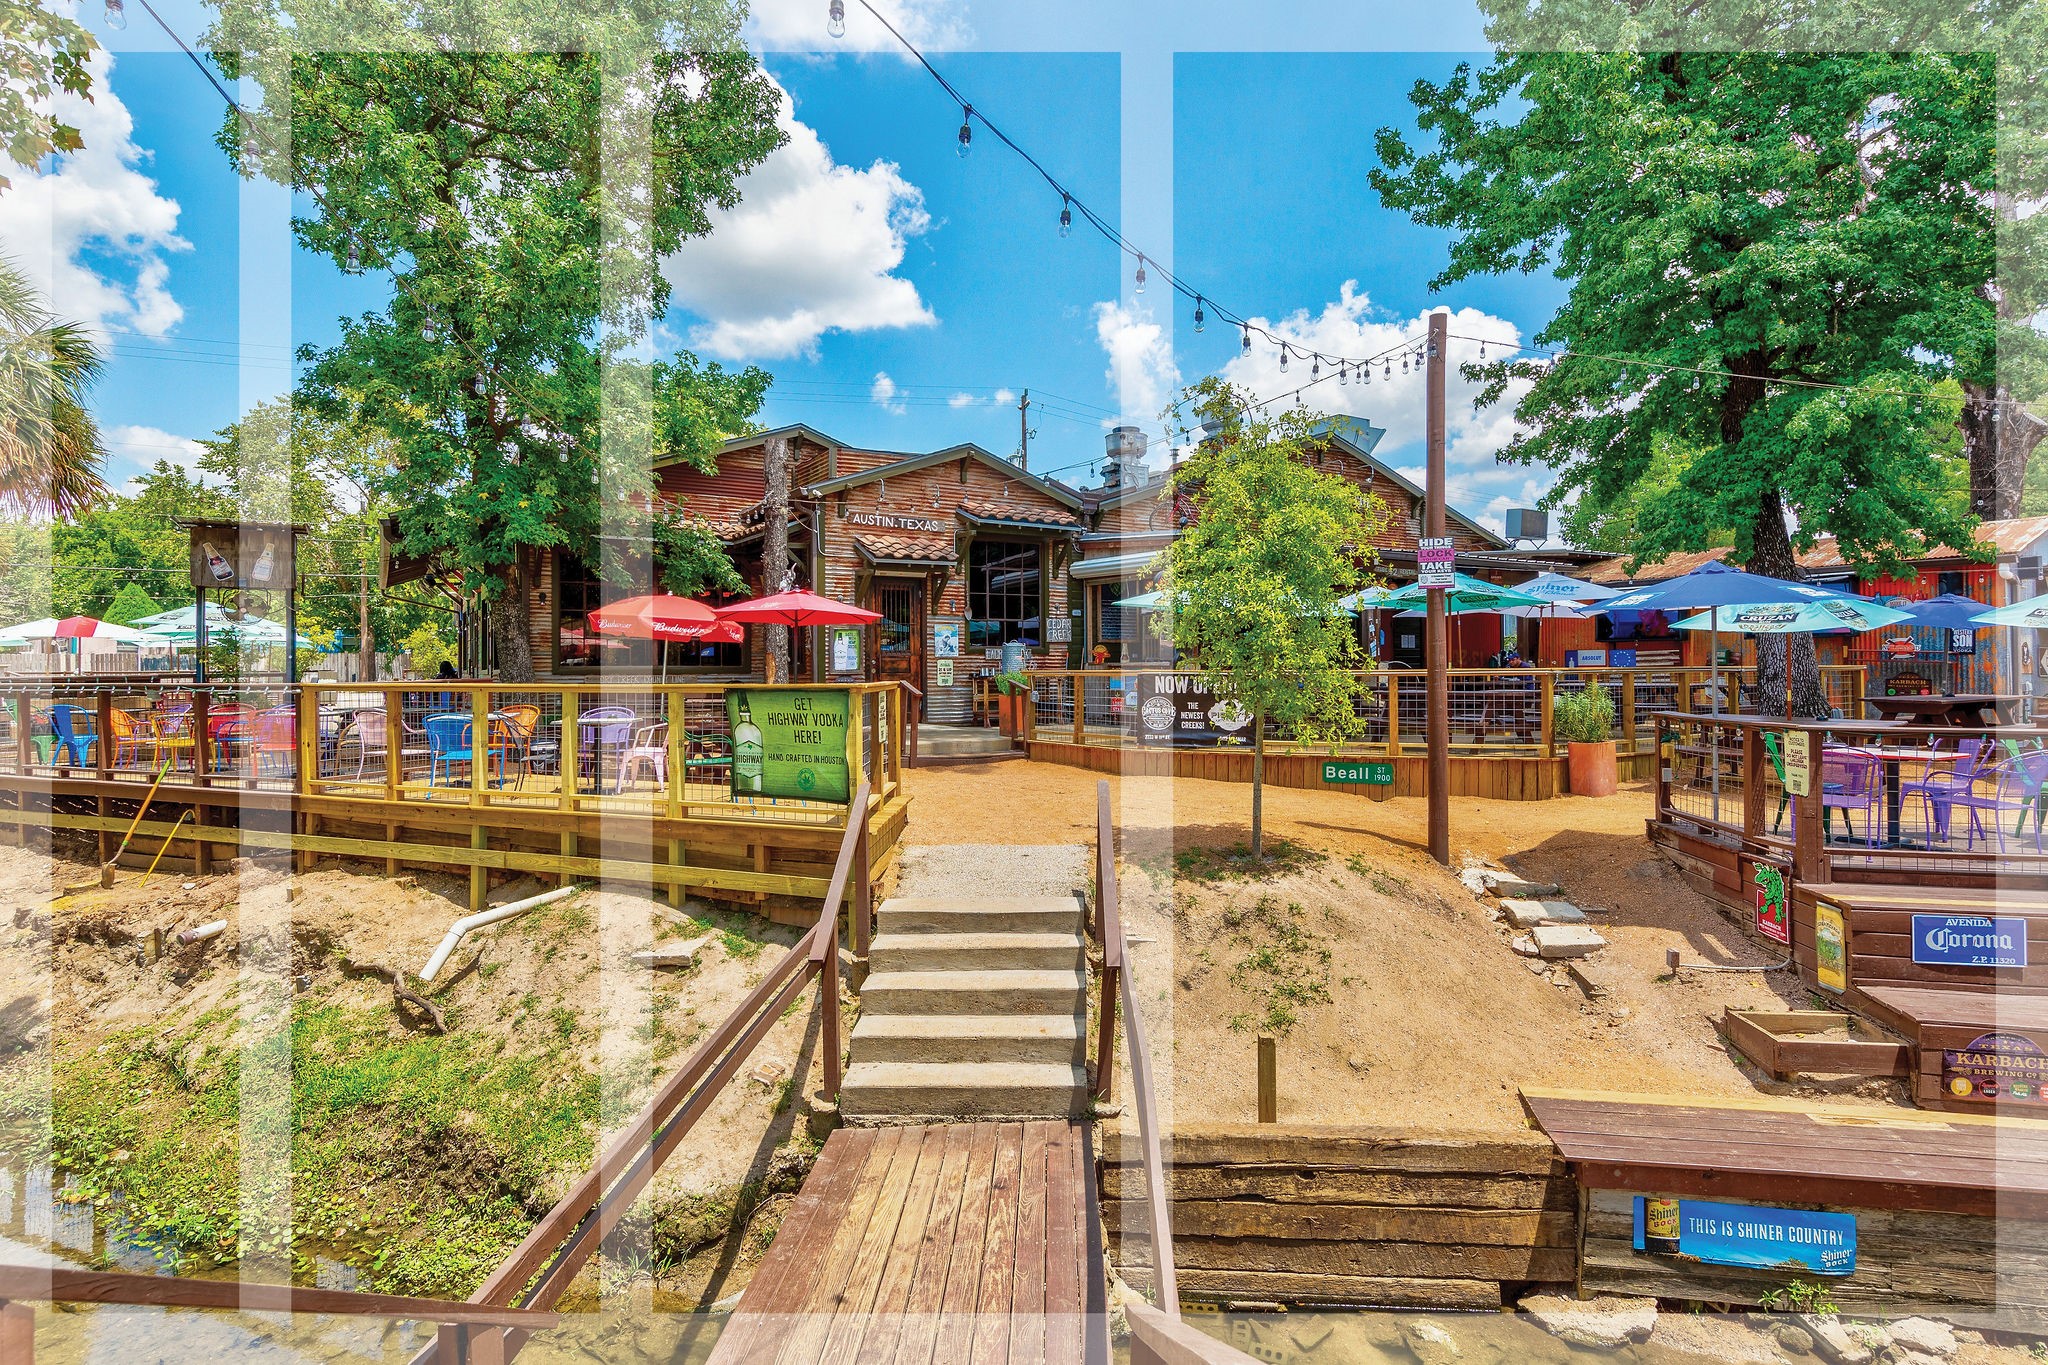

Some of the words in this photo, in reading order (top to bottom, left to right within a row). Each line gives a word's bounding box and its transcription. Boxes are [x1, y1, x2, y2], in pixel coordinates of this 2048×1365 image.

[1418, 537, 1453, 547] HIDE
[1419, 550, 1453, 558] LOCK
[1419, 561, 1453, 570] TAKE
[1046, 618, 1072, 629] CEDAR
[1739, 614, 1795, 622] CRUZAN
[651, 621, 705, 635] Budweiser
[1046, 629, 1072, 641] CREEK
[1952, 634, 1973, 647] SON
[1154, 675, 1189, 694] NOW
[793, 697, 813, 711] GET
[1187, 701, 1199, 710] THE
[767, 712, 809, 727] HIGHWAY
[812, 715, 844, 728] VODKA
[1180, 711, 1204, 720] NEWEST
[1180, 720, 1205, 730] CREEKS!
[793, 730, 822, 744] HERE!
[735, 754, 763, 764] HIGHWAY
[768, 752, 784, 762] HAND
[785, 754, 813, 763] CRAFTED
[820, 757, 846, 766] HOUSTON
[1325, 766, 1369, 780] Beall
[1376, 766, 1385, 774] ST
[1373, 774, 1391, 782] 1900
[1945, 918, 1992, 927] AVENIDA
[1925, 927, 2014, 954] Corona
[1971, 955, 1988, 964] Z.P.
[1989, 957, 2016, 965] 11320
[1978, 1043, 2033, 1052] TEXAS
[1955, 1052, 2048, 1070] KARBACH
[1974, 1068, 2024, 1078] BREWING
[1649, 1206, 1678, 1222] Shiner
[1653, 1218, 1677, 1228] BOCK
[1688, 1217, 1717, 1236] THIS
[1720, 1220, 1734, 1238] IS
[1737, 1222, 1784, 1243] SHINER
[1787, 1225, 1845, 1247] COUNTRY
[1819, 1248, 1854, 1263] Shiner
[1824, 1258, 1849, 1269] BOCK
